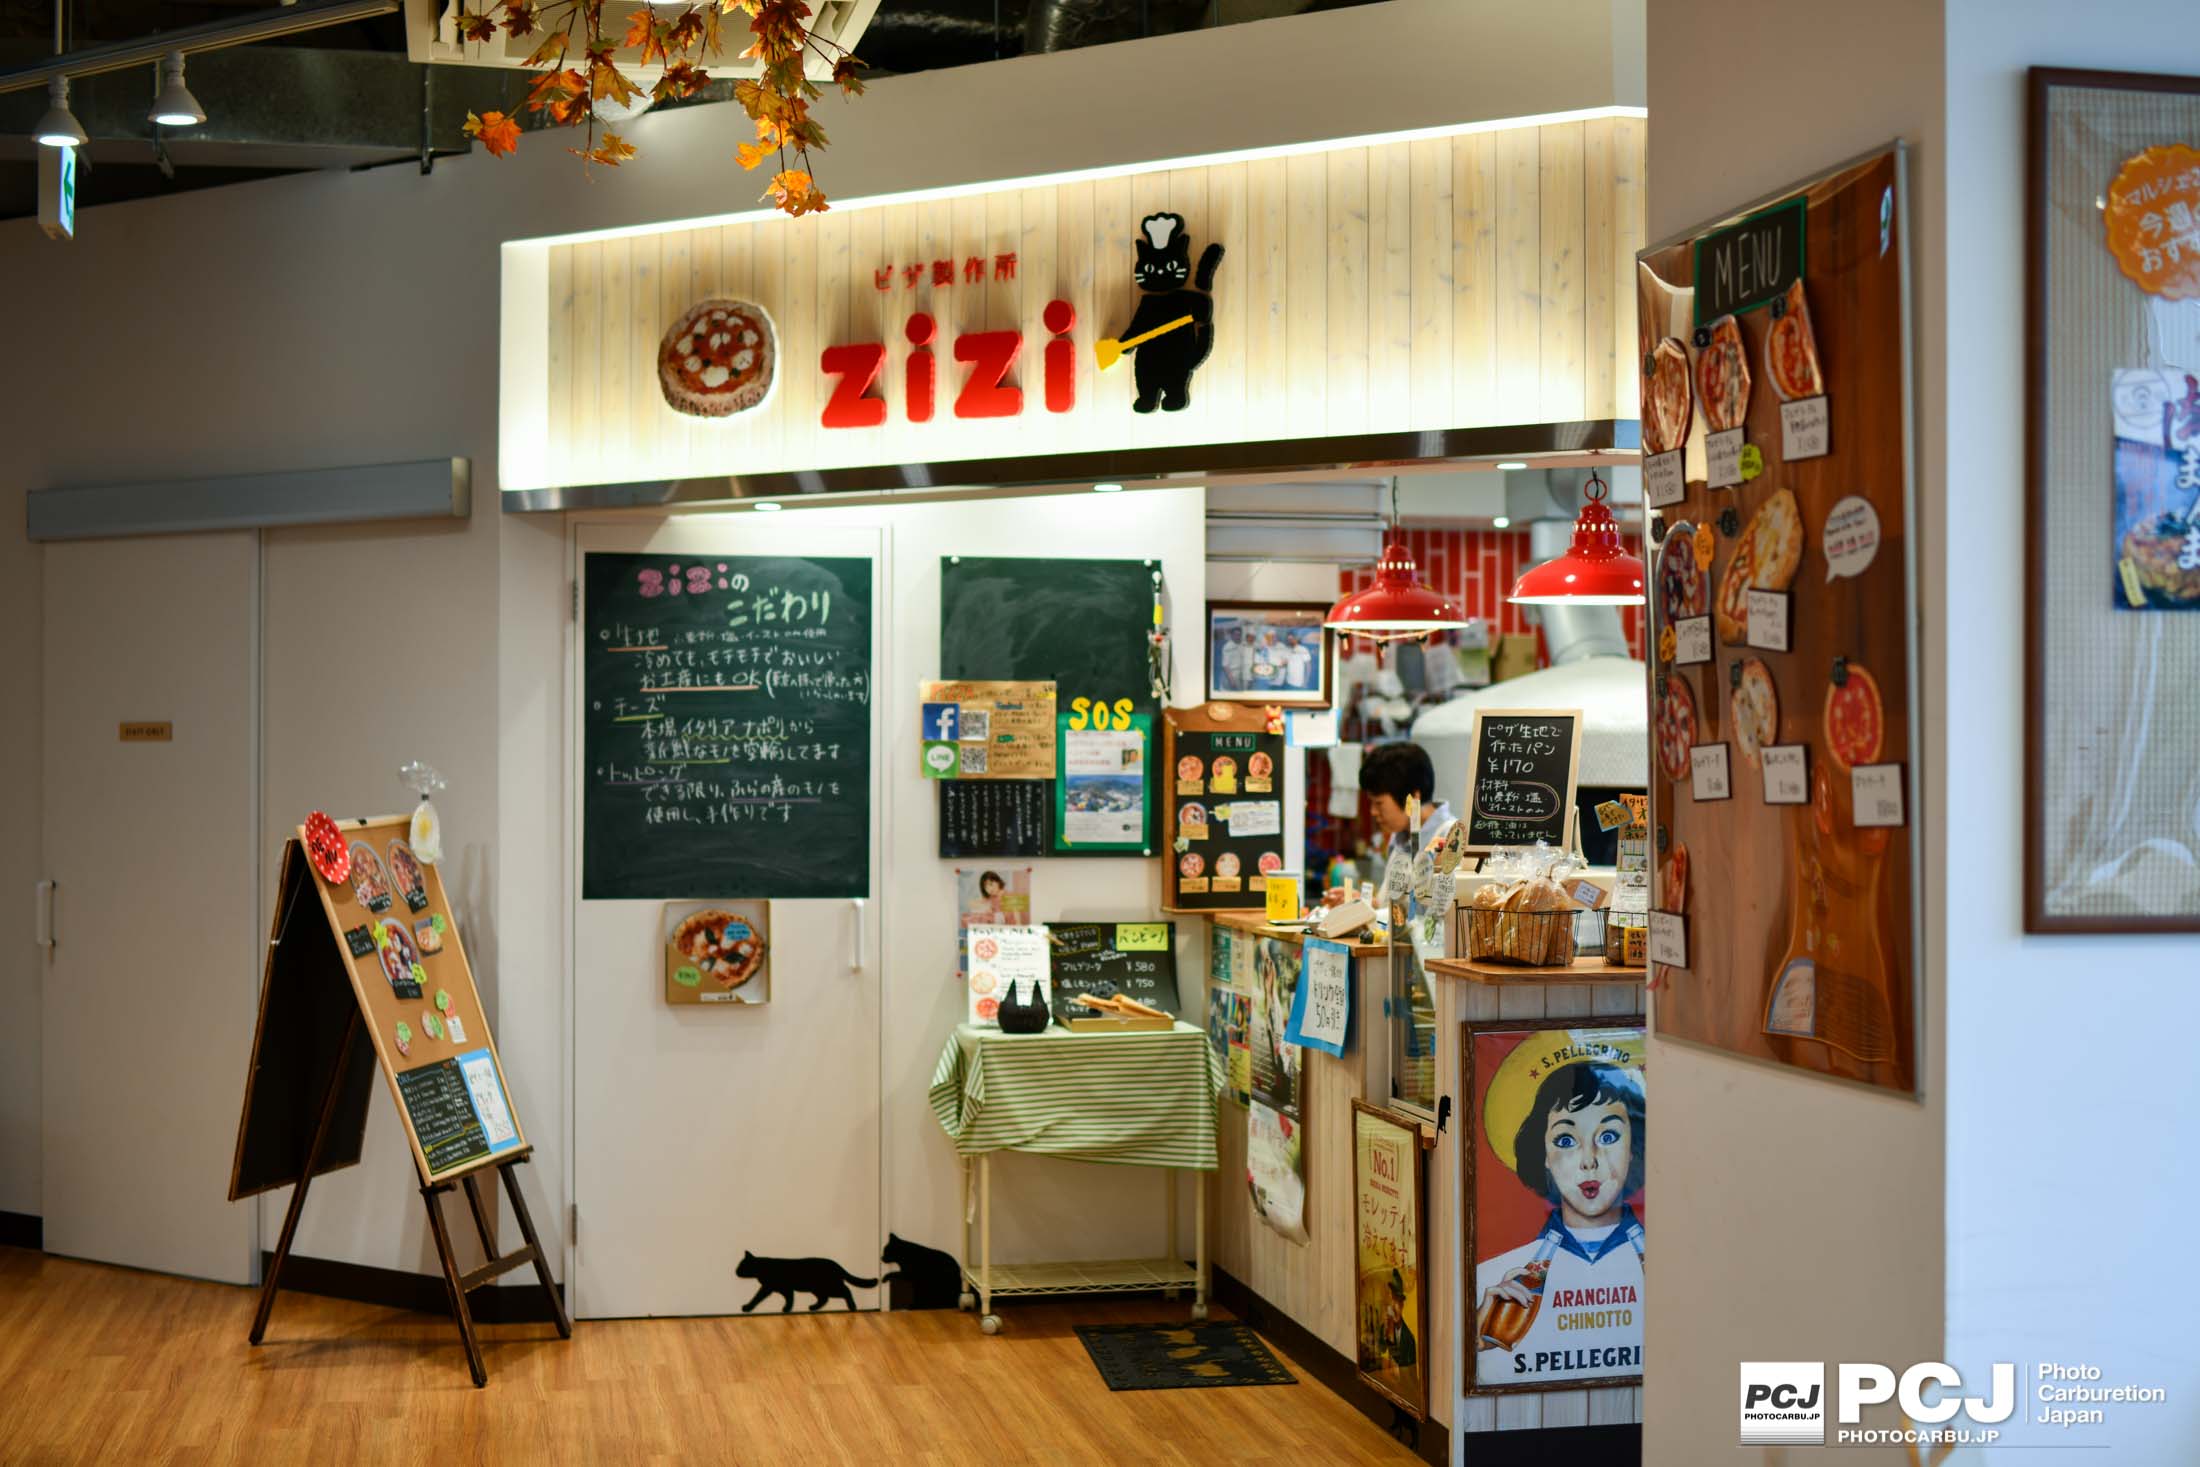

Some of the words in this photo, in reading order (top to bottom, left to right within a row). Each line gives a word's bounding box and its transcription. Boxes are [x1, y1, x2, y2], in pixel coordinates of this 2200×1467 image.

[874, 252, 1017, 292] ピザ製作所
[1714, 226, 1783, 310] MENU
[727, 586, 831, 627] こだわり
[614, 694, 666, 716] チーズ
[1069, 697, 1134, 731] SOS
[1215, 736, 1252, 748] MENU
[1488, 723, 1562, 739] ピザ生地で
[1490, 739, 1556, 756] 作ったパン
[1488, 757, 1534, 774] ¥170
[1541, 1042, 1631, 1069] S.PELLEGRINO
[1373, 1149, 1395, 1182] No.1
[1552, 1285, 1638, 1308] ARANCIATA
[1557, 1309, 1632, 1332] CHINOTTO
[1514, 1345, 1641, 1374] S.PELLEGRI
